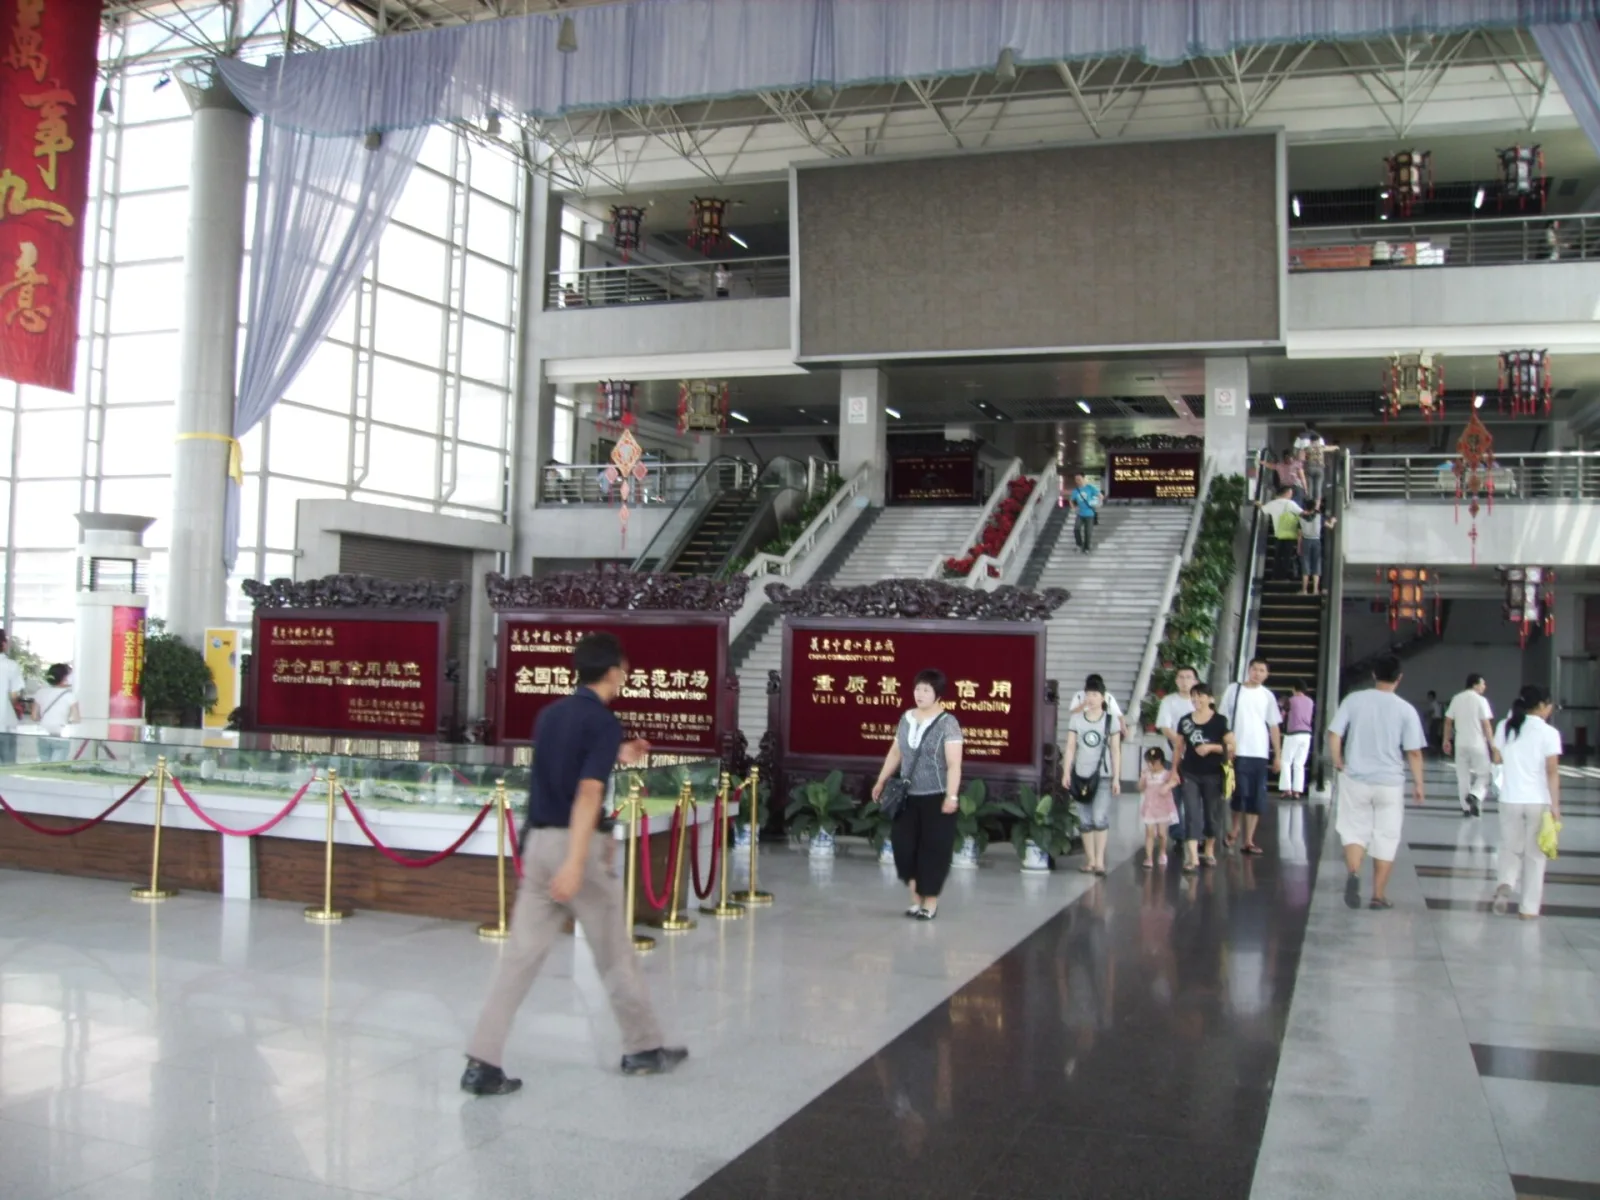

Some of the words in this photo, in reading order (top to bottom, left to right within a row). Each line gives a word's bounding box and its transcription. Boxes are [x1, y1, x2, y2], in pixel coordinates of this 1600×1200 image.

[272, 674, 304, 684] Contract
[335, 676, 380, 688] Trustworthy
[812, 674, 901, 695] 重质量
[514, 684, 549, 694] National
[622, 687, 651, 698] Credit
[653, 688, 708, 701] Supervision
[812, 693, 846, 705] Value
[856, 695, 903, 708] Quality
[960, 700, 1011, 714] Credibility
